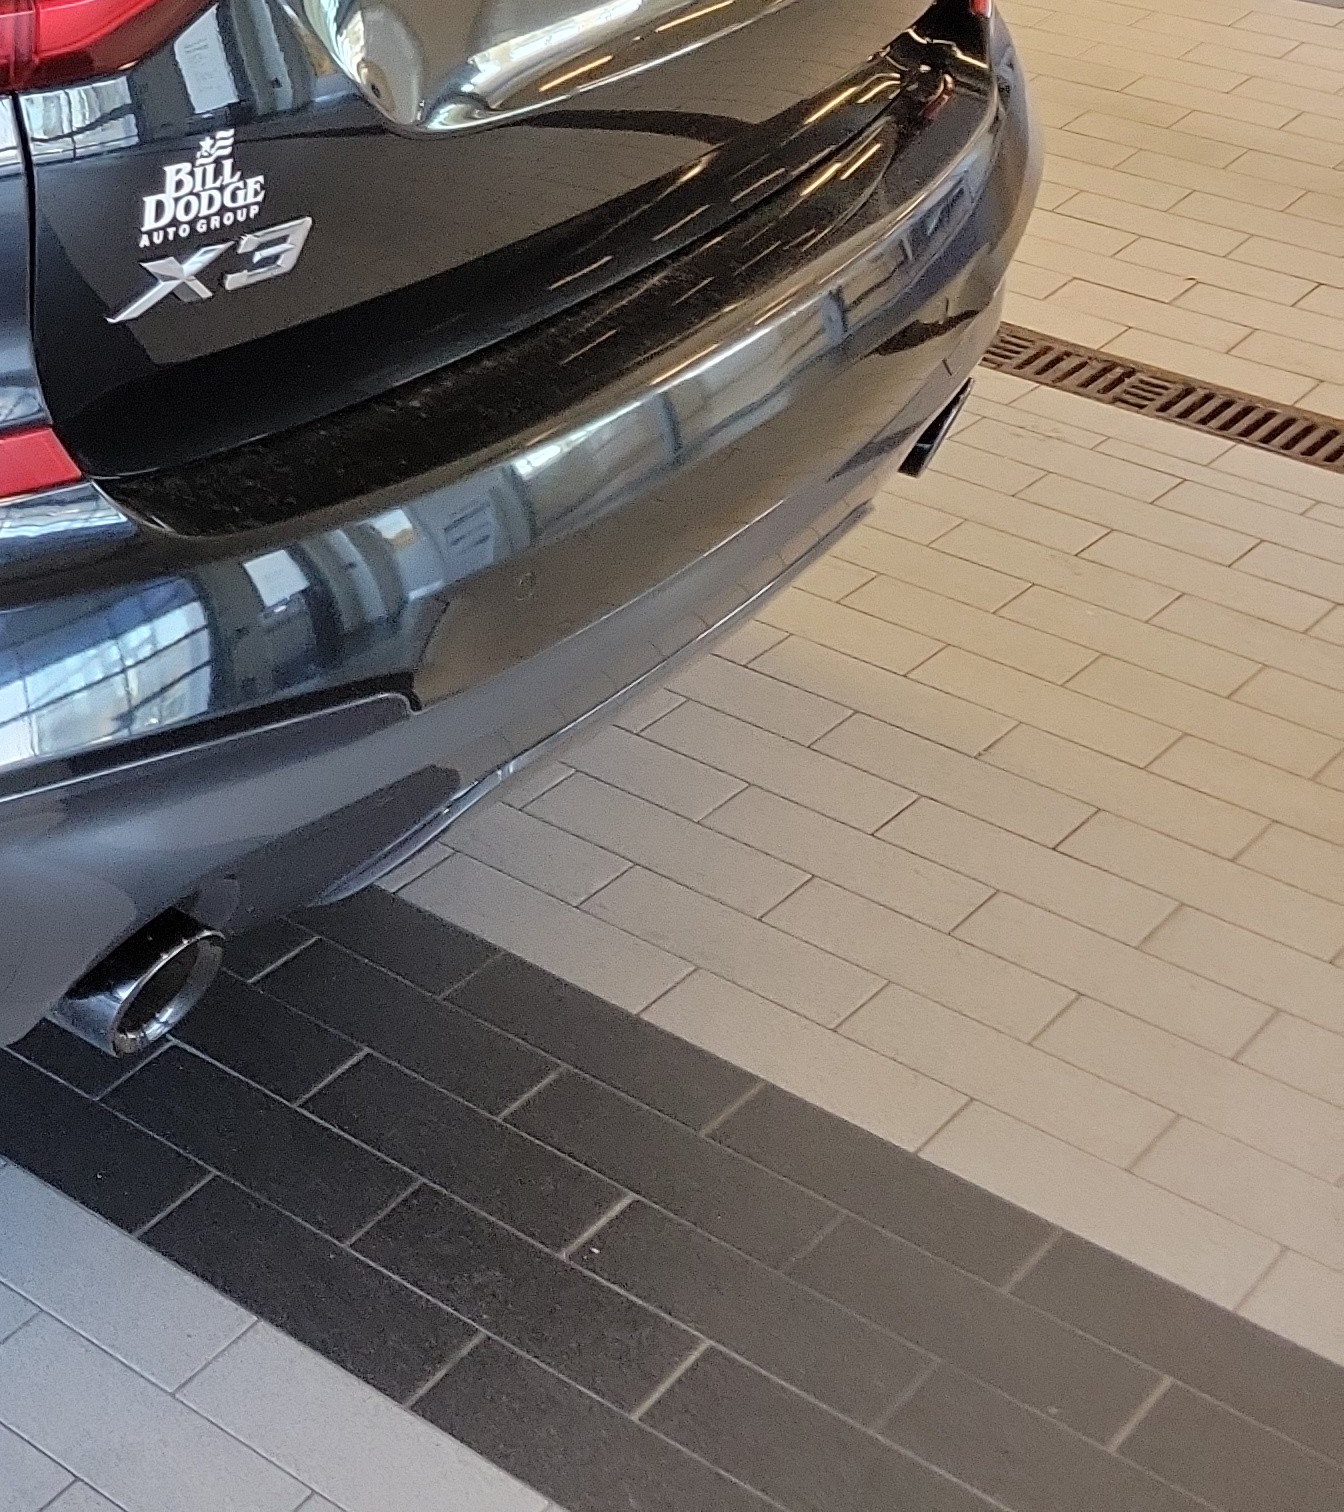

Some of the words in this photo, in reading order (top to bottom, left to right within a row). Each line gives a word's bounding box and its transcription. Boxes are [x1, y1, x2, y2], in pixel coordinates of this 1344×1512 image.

[141, 175, 265, 233] DODGE
[163, 158, 242, 199] BILL
[138, 224, 191, 248] AUTO
[195, 204, 260, 234] GROUP
[104, 216, 313, 324] X3
